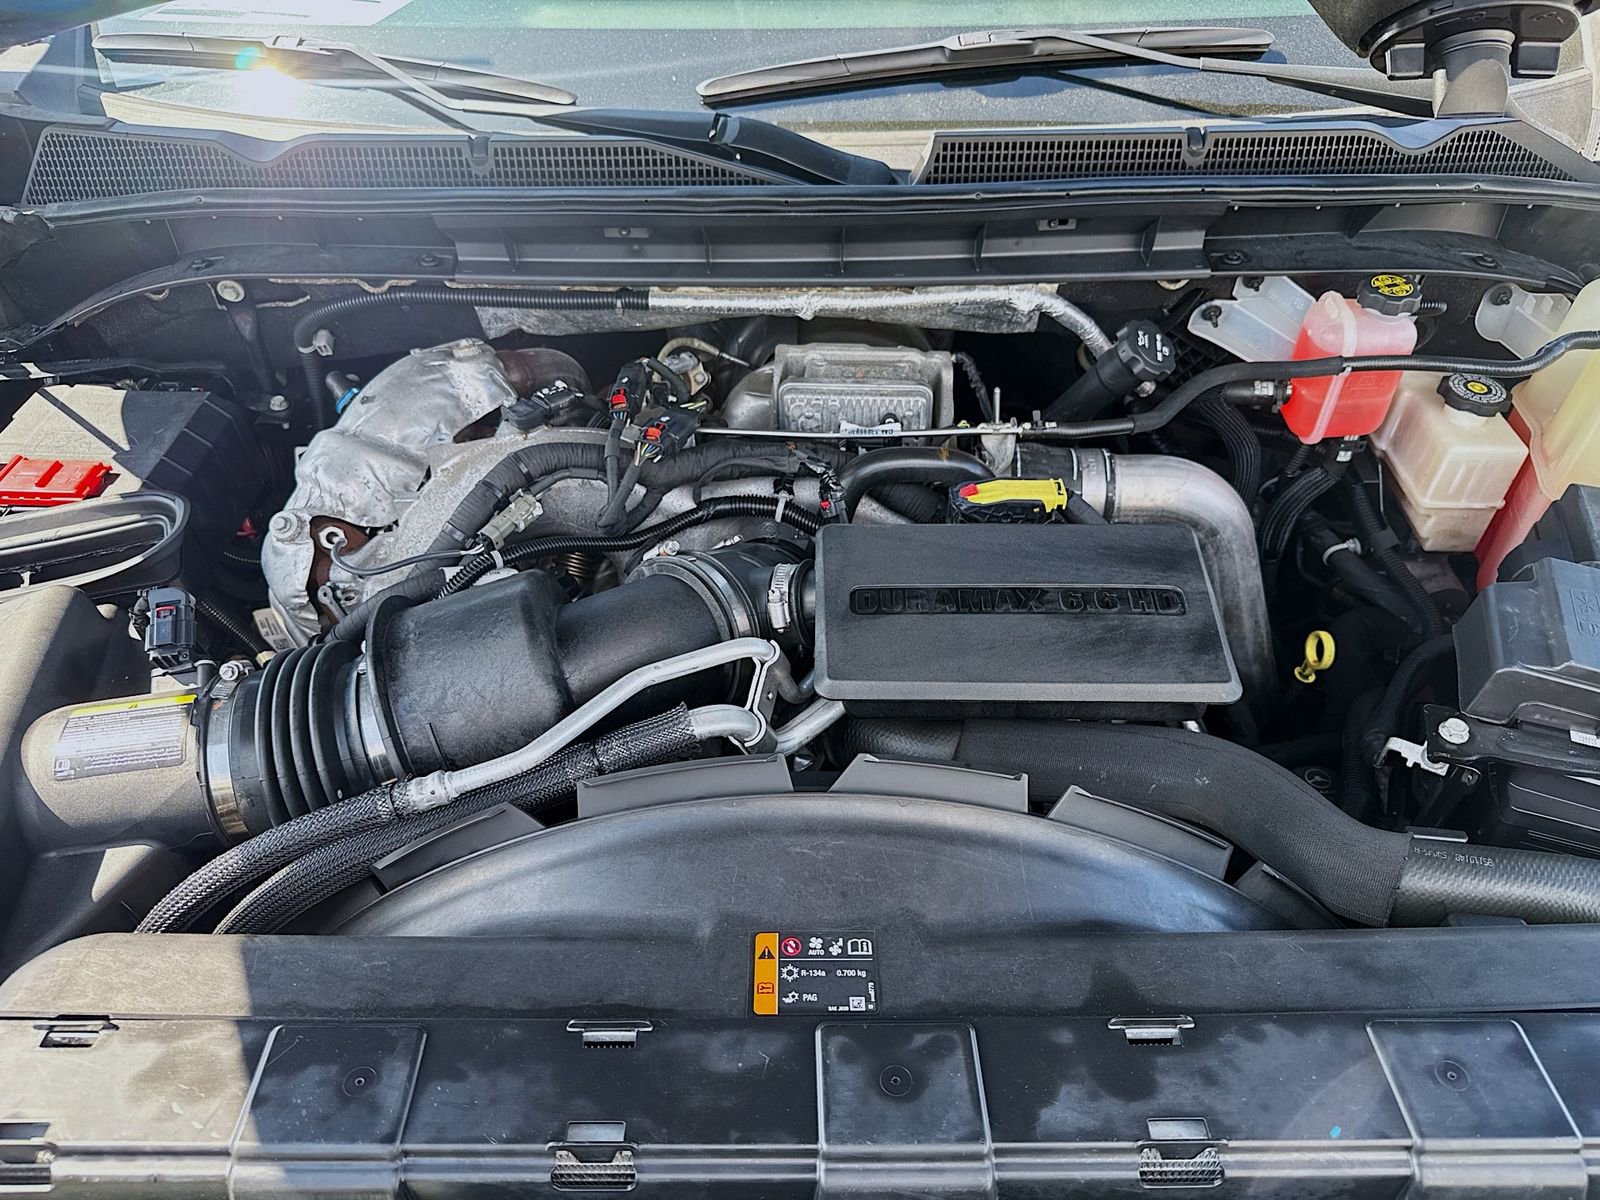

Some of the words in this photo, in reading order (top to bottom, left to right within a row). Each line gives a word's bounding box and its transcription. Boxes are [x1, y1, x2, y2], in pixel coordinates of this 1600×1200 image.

[854, 589, 1045, 613] DURAMAX
[1058, 590, 1120, 612] 6.6
[1128, 589, 1184, 613] HD
[801, 969, 826, 977] R-134a
[857, 969, 866, 977] kg
[802, 993, 818, 1001] PAG
